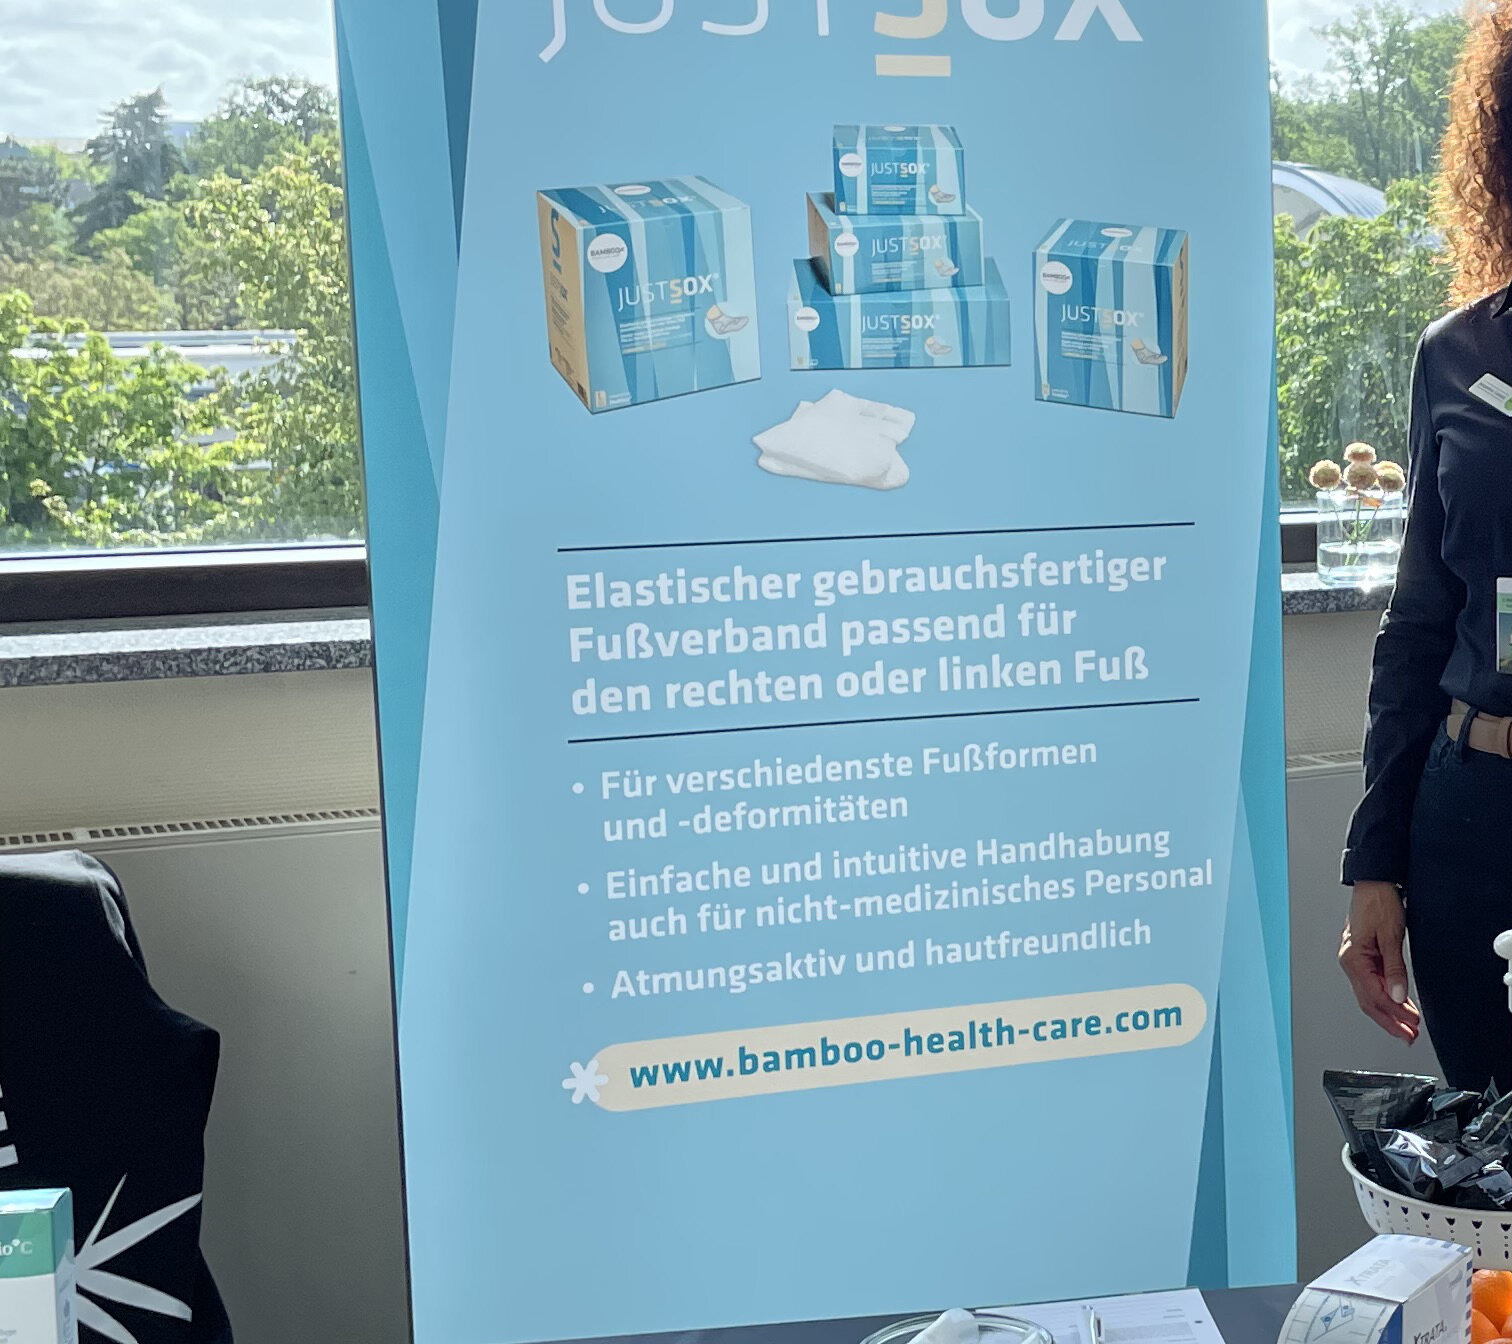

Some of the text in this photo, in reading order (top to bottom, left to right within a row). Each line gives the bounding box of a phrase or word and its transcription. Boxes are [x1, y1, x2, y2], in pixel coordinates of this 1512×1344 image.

[567, 549, 1167, 610] Elastischer gebrauchsfertiger
[569, 601, 1077, 662] Fußverband passend für
[571, 645, 1150, 716] den rechten oder linken Fuß
[600, 739, 1098, 800] Für verschiedenste Fußformen
[603, 792, 909, 843] und -deformitäten
[605, 827, 1171, 901] Einfache und intuitive Handhabung
[607, 858, 1214, 942] auch für nicht-medizinisches Personal
[610, 917, 1152, 999] Atmungsaktiv und hautfreundlich
[629, 1001, 1184, 1089] www.bamboo-health-care.com
